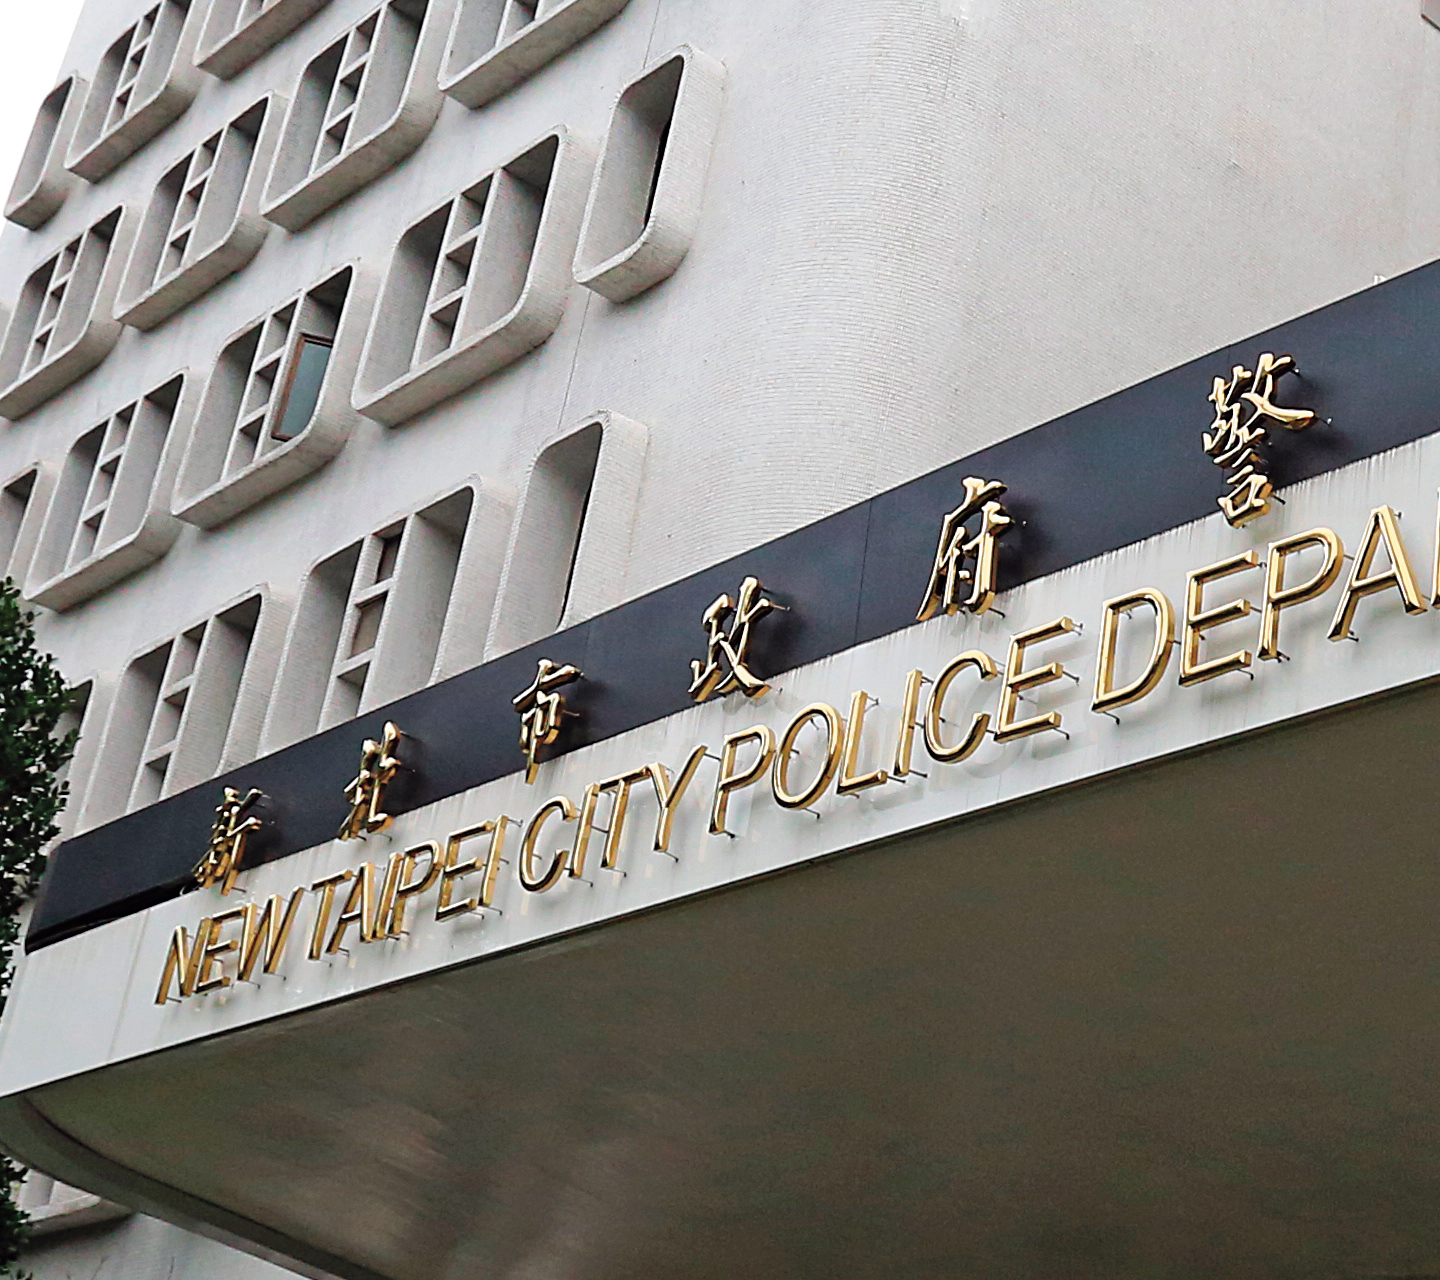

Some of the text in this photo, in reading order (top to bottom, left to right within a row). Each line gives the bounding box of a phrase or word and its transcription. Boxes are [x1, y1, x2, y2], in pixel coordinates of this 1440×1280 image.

[155, 886, 303, 1005] NEW
[308, 816, 508, 960] TAIPEI
[518, 744, 706, 894] CITY
[709, 617, 1076, 836] POLICE
